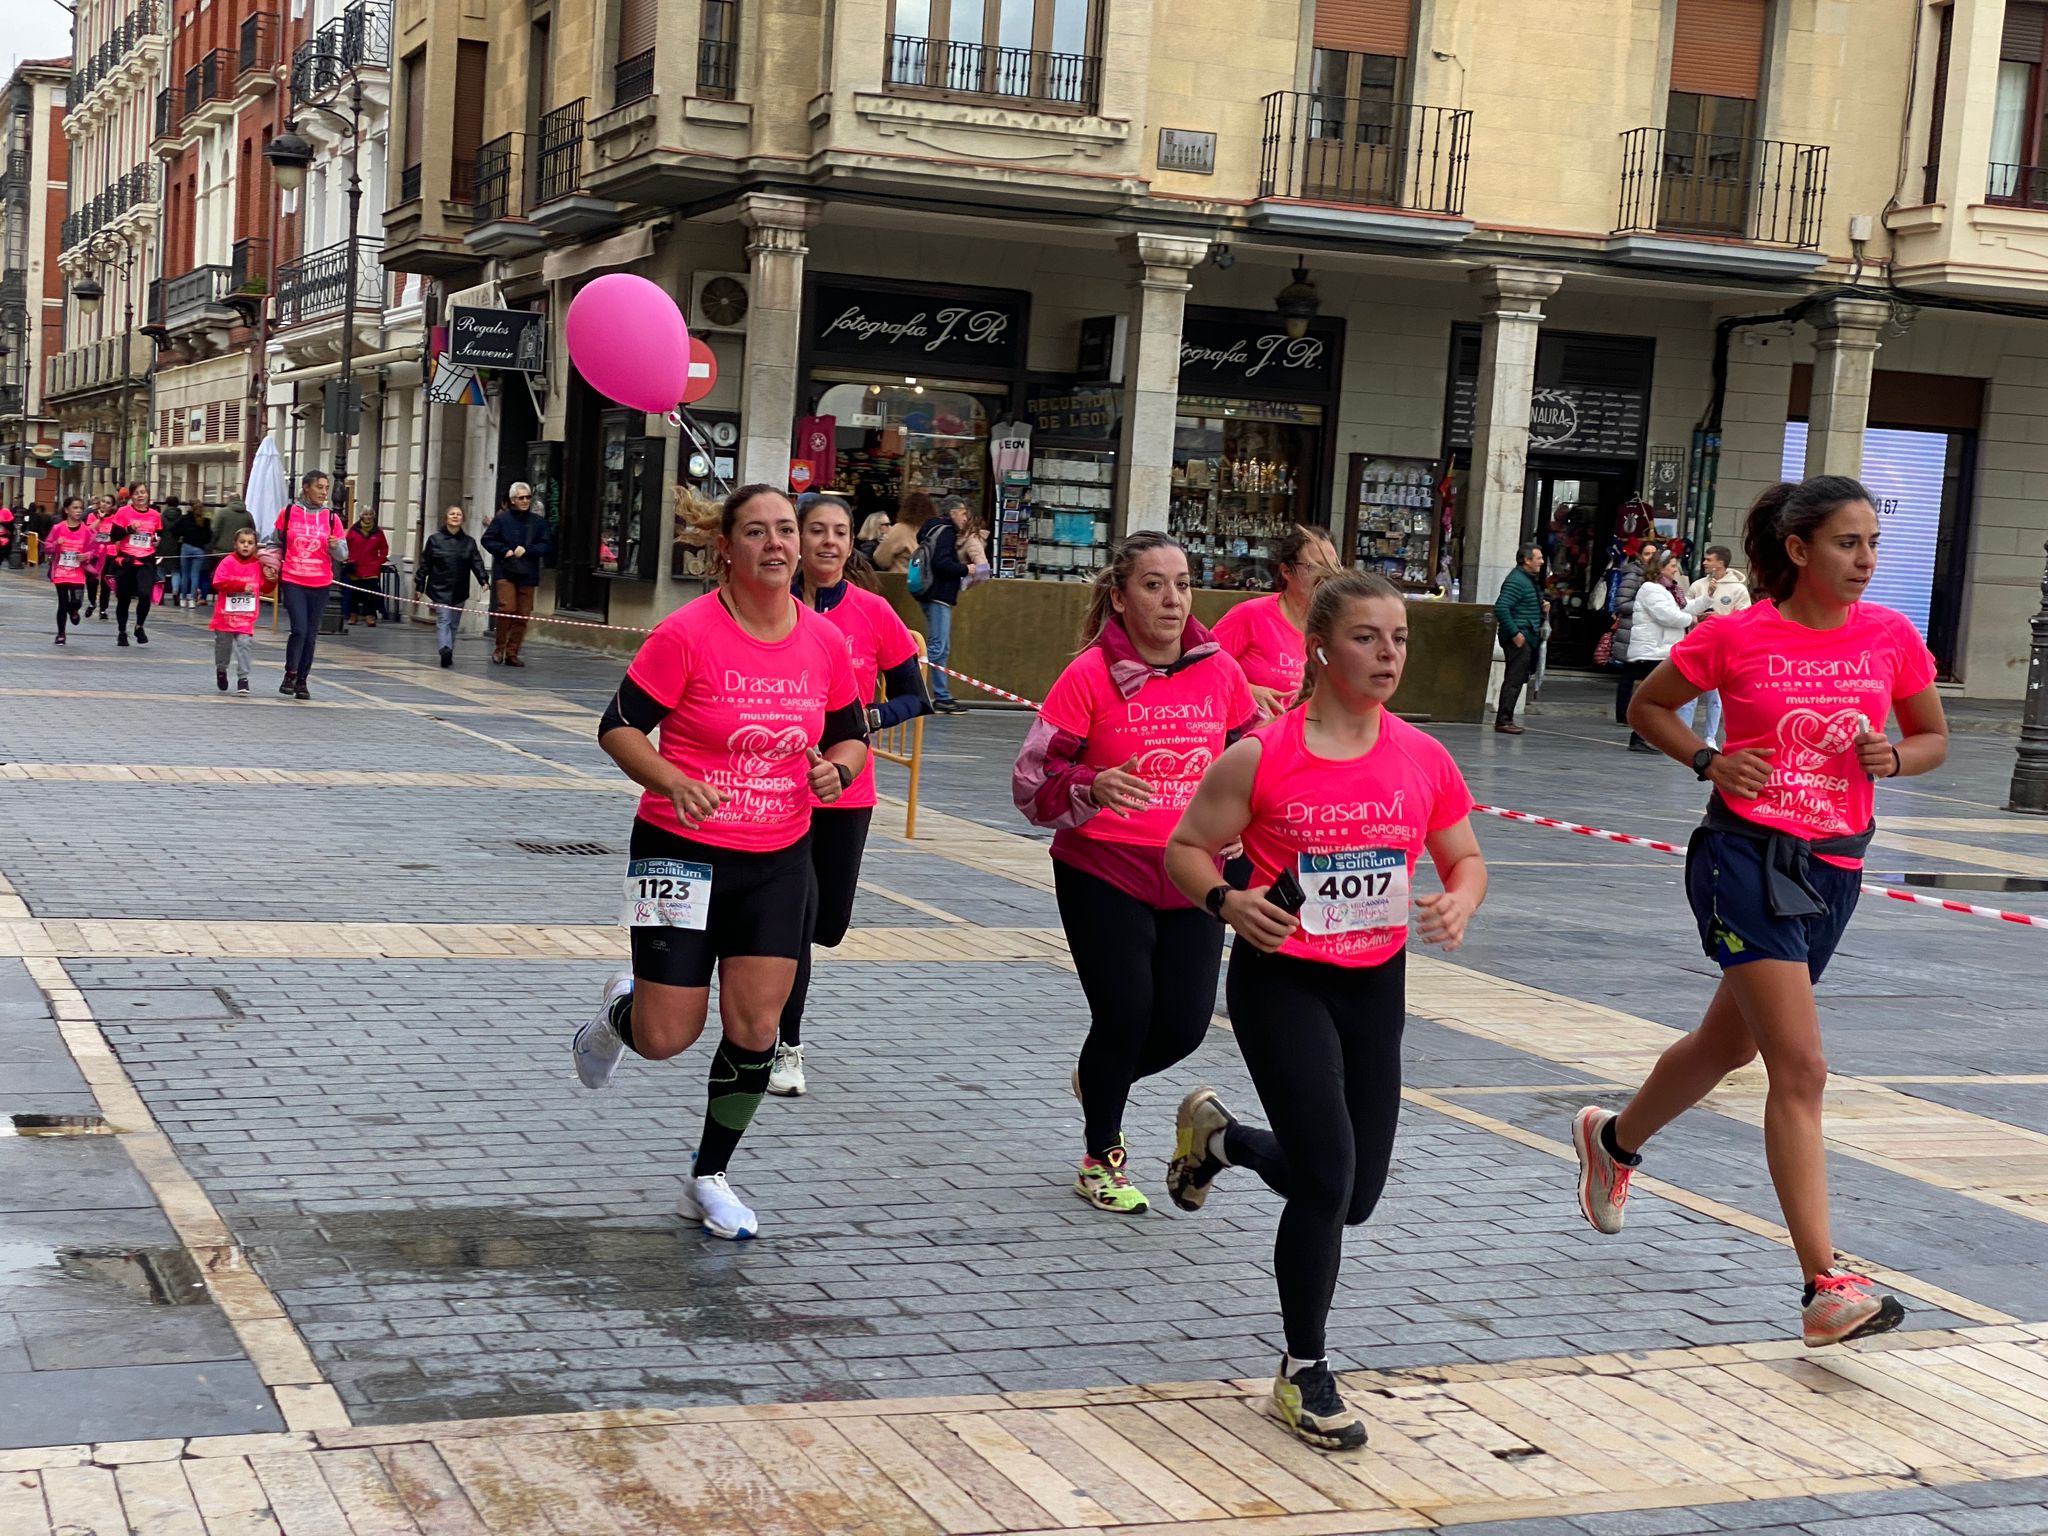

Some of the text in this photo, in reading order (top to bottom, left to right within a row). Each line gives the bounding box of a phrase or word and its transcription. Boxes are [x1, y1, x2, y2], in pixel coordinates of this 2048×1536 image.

[456, 316, 509, 339] Regalos
[820, 306, 928, 344] fotografia
[456, 341, 514, 359] Souvenir
[1180, 340, 1248, 370] tografia
[1039, 415, 1061, 430] DE
[1768, 650, 1871, 677] Drasanvi
[725, 670, 809, 694] Drasanvi
[1834, 679, 1885, 689] CAROBELS
[1127, 695, 1213, 723] Drasanvi
[1185, 721, 1225, 730] CAROBELS
[1286, 790, 1405, 824] Drasanvi
[1361, 824, 1417, 839] CAROBELS
[648, 860, 684, 869] GRUPO
[1334, 850, 1377, 860] GRUPO
[638, 879, 691, 900] 1123
[1318, 872, 1392, 900] 4017
